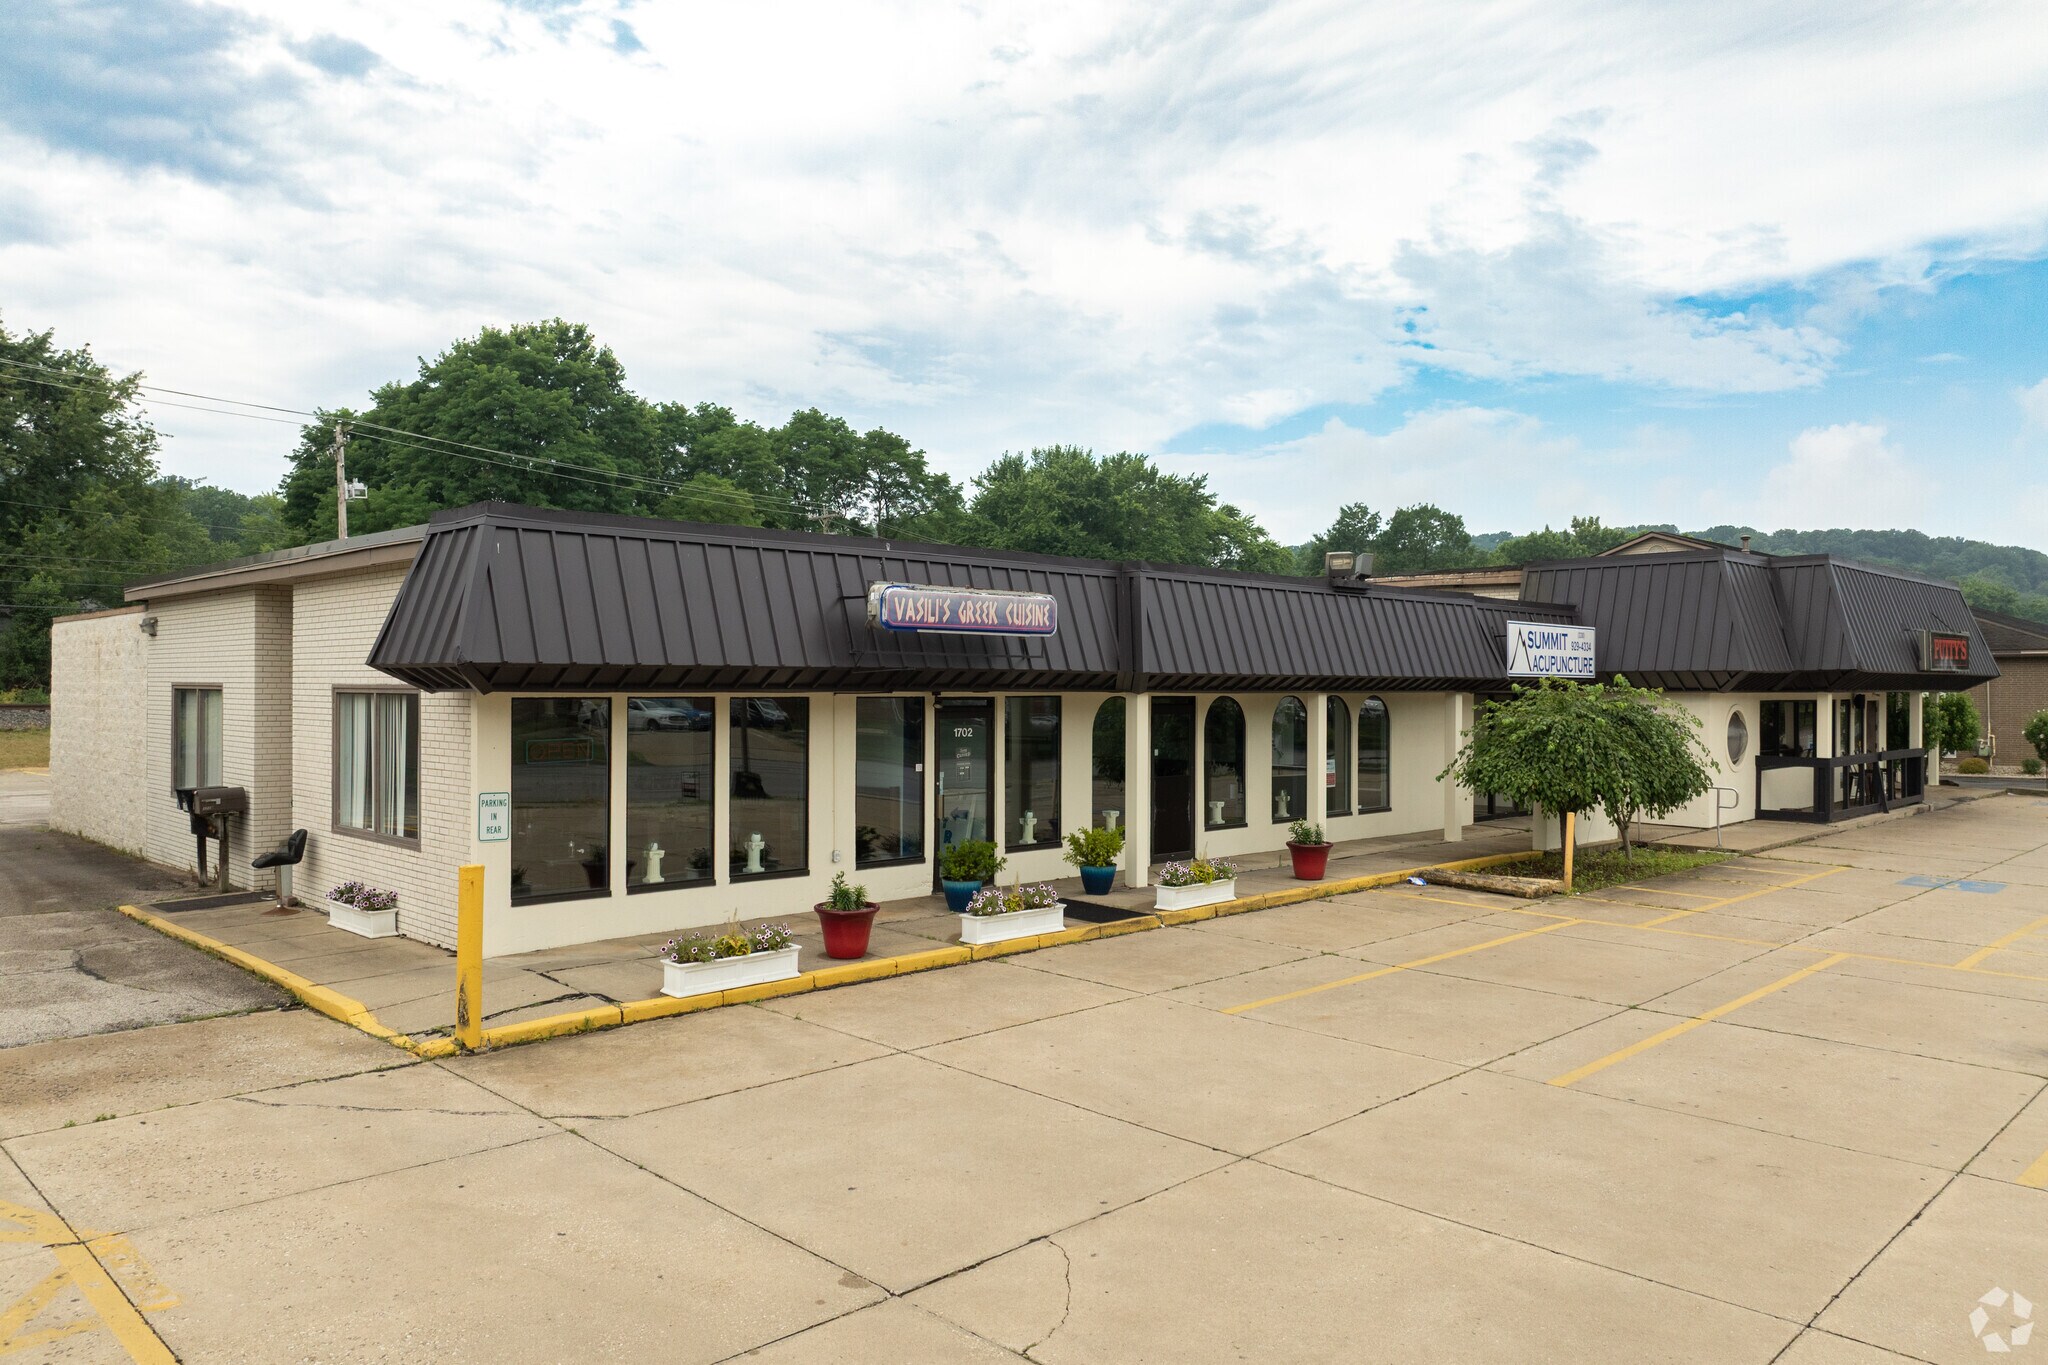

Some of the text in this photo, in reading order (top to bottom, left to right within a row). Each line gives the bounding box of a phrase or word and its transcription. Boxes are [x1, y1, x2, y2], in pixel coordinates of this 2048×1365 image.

[894, 596, 1050, 627] VASILI'S GREEK CUISINE
[1527, 630, 1568, 650] SUMMIT
[1571, 641, 1592, 652] 929-4334
[1532, 655, 1593, 673] ACUPUNCTURE
[953, 727, 973, 738] 1702
[529, 742, 590, 761] OPEN
[481, 799, 507, 808] PARKING
[490, 812, 497, 821] IN
[486, 825, 502, 834] REAR
